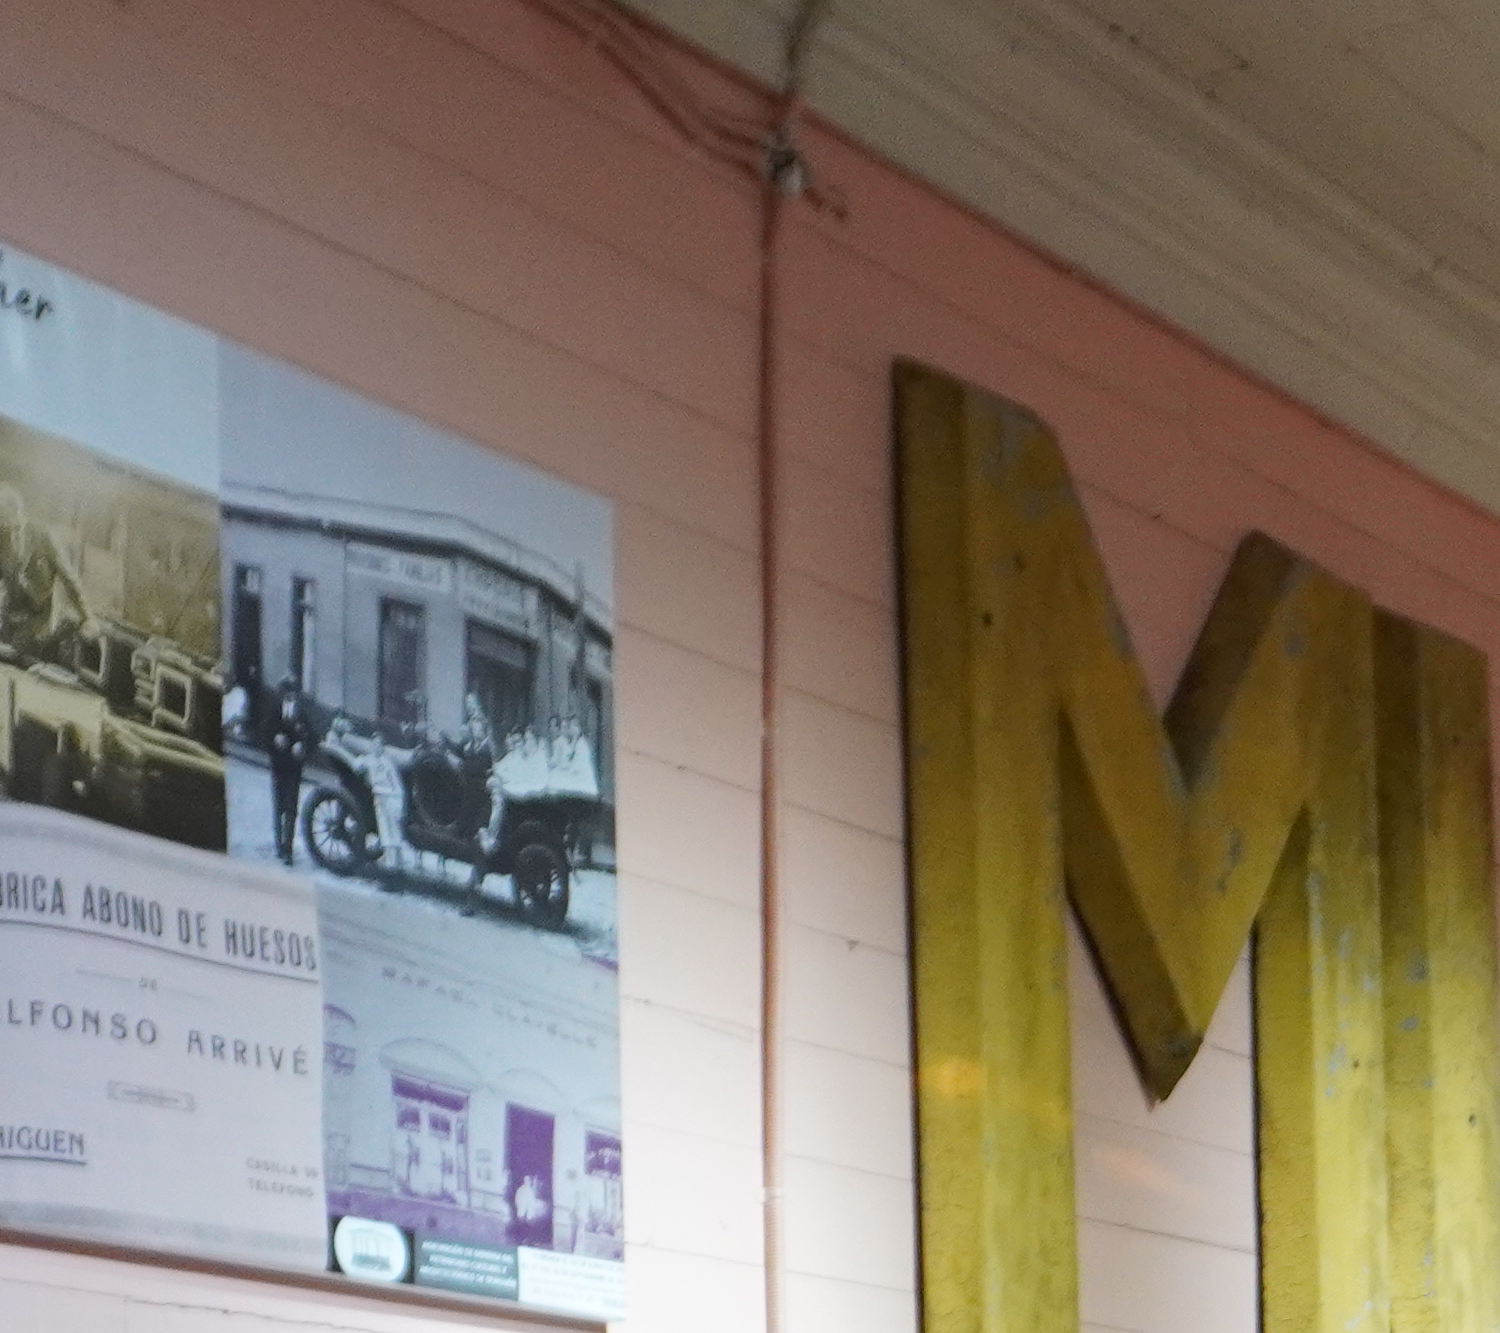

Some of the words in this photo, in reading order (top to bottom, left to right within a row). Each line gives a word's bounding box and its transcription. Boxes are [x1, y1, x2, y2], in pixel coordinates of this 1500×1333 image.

[82, 883, 164, 938] ABONO
[177, 908, 208, 949] DE
[223, 918, 318, 971] HUESOS
